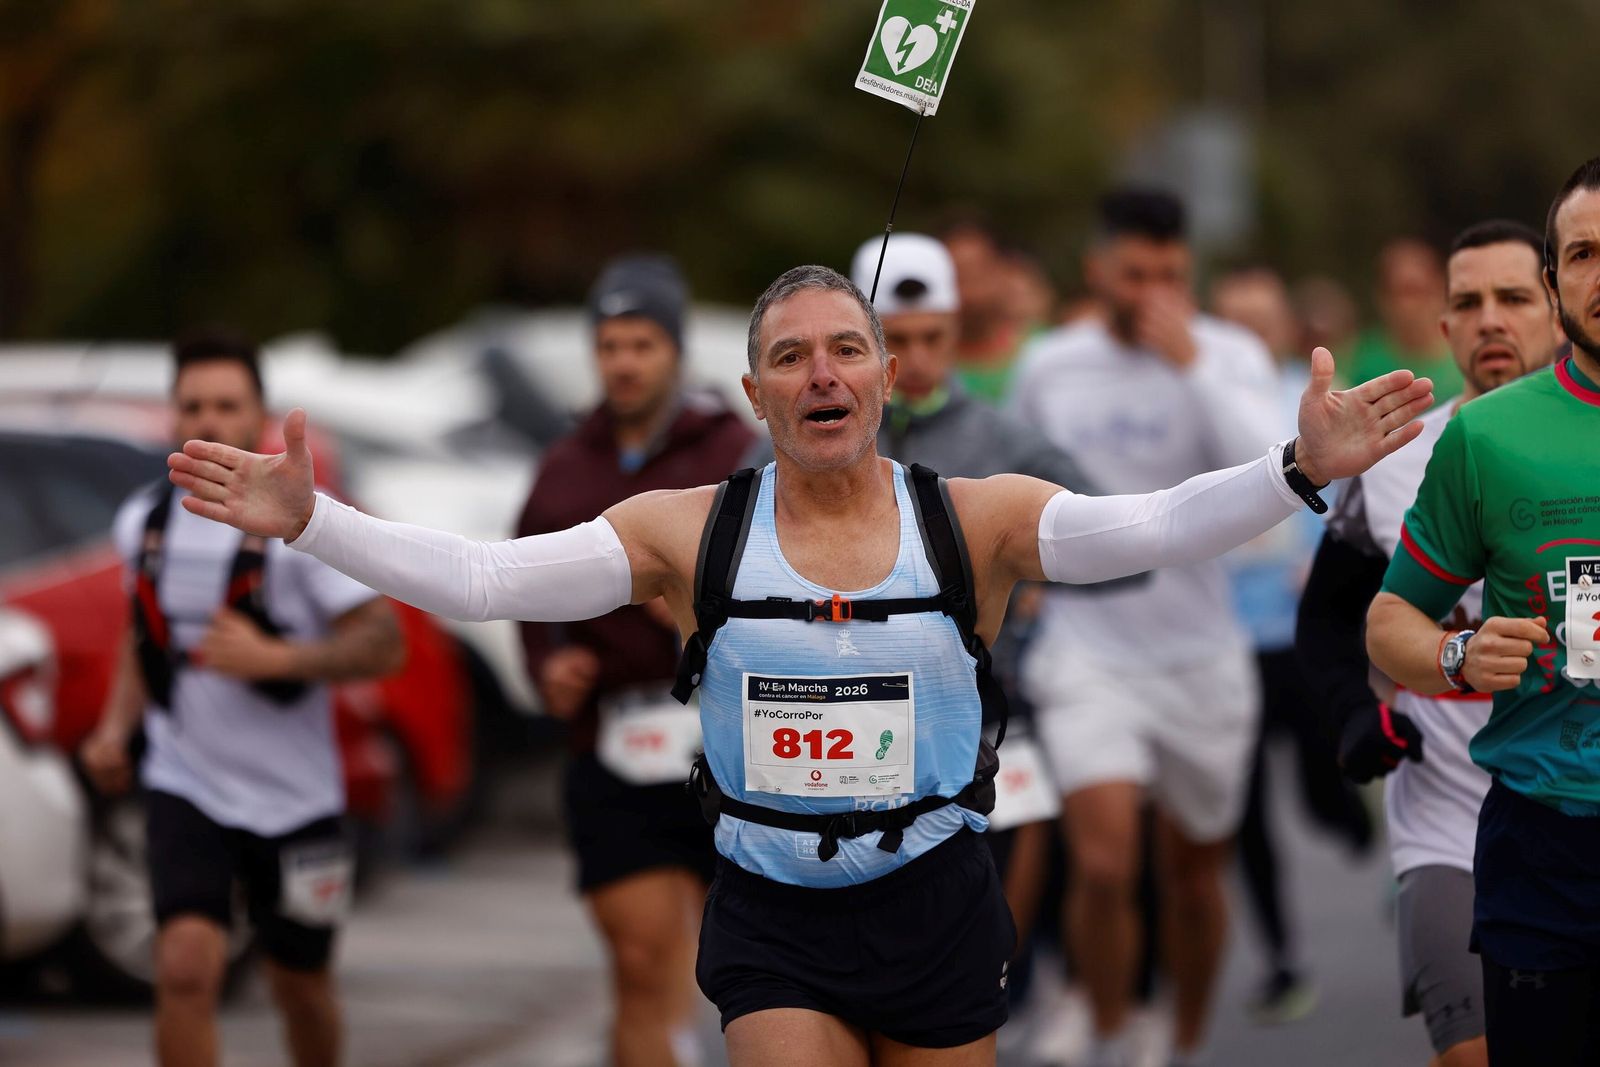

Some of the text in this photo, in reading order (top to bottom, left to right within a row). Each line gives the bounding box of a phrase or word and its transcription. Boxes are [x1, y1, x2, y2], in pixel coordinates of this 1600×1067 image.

[915, 75, 938, 94] DEA
[1585, 496, 1600, 505] esp
[1540, 508, 1567, 517] contra
[1568, 505, 1576, 514] el
[1580, 563, 1600, 574] IV E
[1576, 592, 1600, 603] #Yo
[758, 682, 868, 697] IV En Marcha 2026
[754, 709, 824, 721] #YoCorroPor
[772, 727, 854, 760] 812
